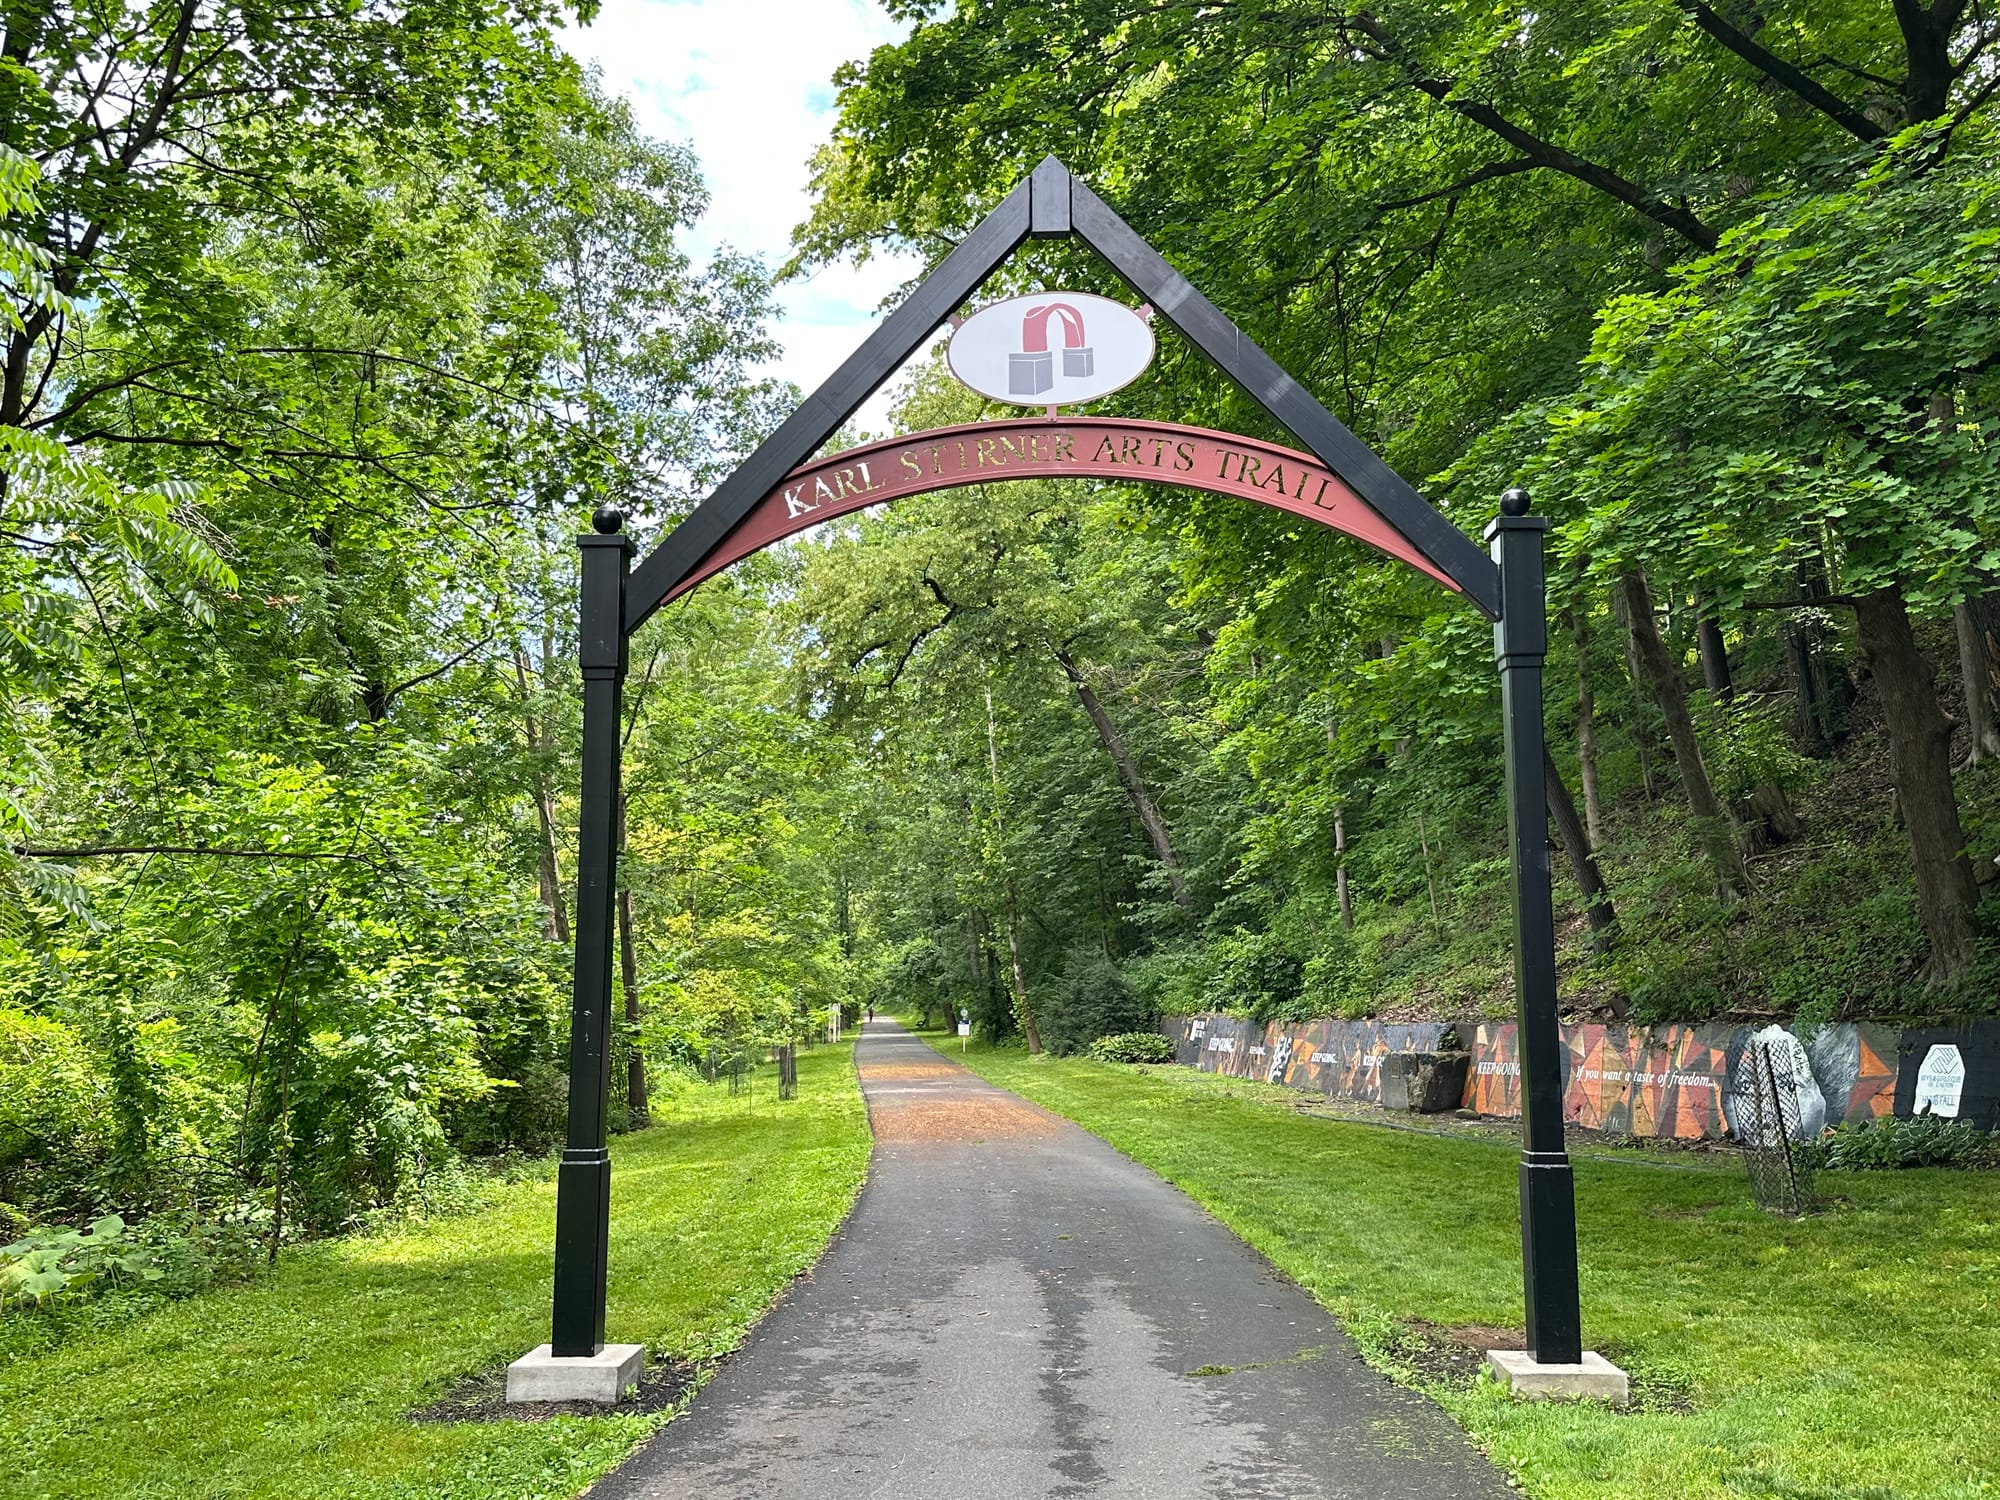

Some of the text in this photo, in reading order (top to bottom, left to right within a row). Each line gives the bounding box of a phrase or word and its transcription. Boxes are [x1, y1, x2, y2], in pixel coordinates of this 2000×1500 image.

[783, 433, 1337, 519] KARL STIRNER ARTS TRAIL
[1477, 1062, 1496, 1075] KEEP
[1576, 1065, 1583, 1081] If
[1584, 1069, 1599, 1082] you
[1602, 1070, 1622, 1081] want
[1625, 1072, 1631, 1082] a
[1633, 1071, 1654, 1083] taste
[1657, 1071, 1668, 1087] of
